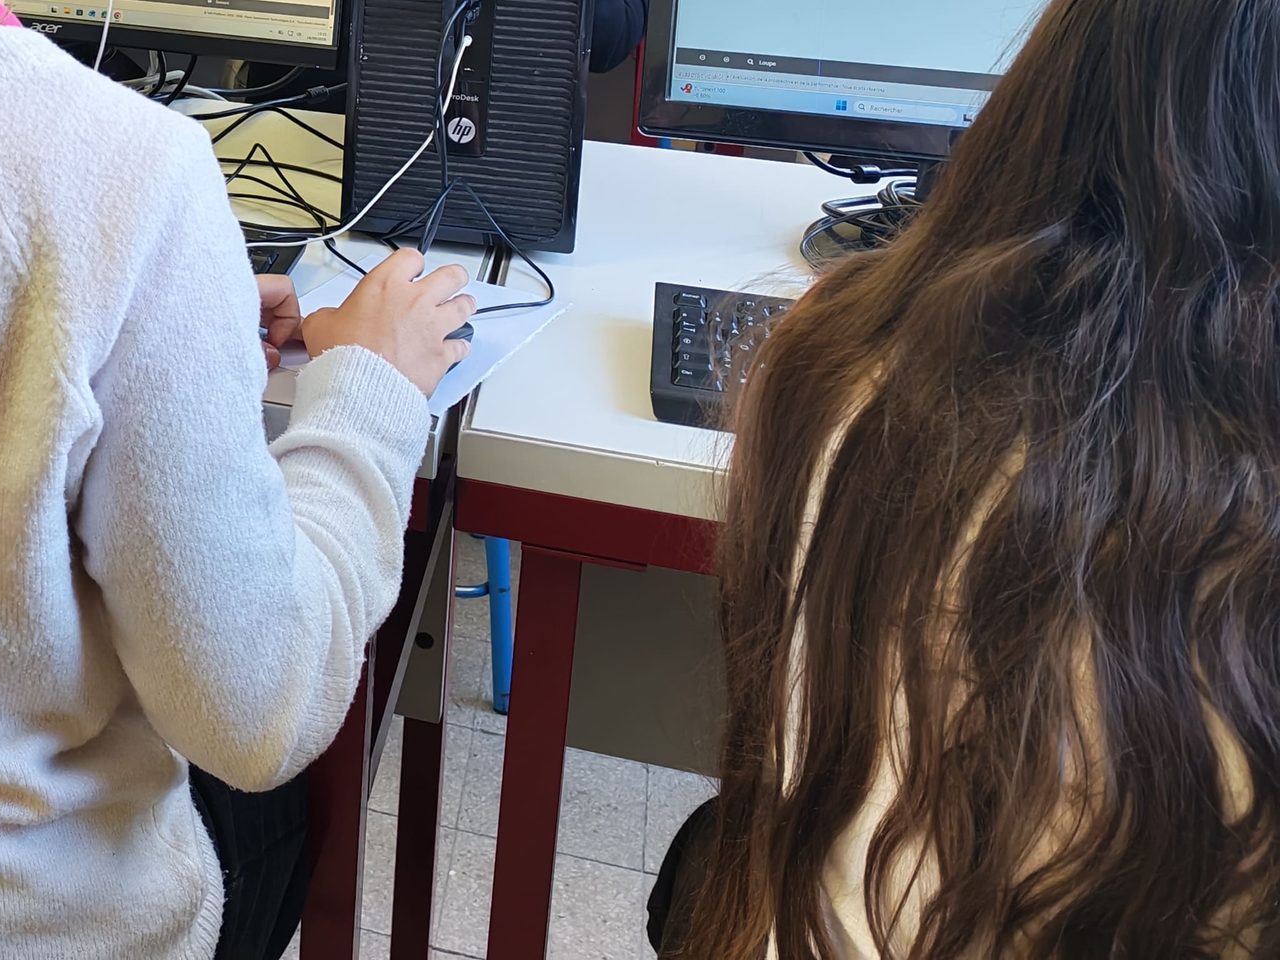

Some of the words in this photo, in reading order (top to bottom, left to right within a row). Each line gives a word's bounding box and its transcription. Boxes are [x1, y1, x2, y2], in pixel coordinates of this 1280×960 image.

[30, 22, 63, 34] acer
[758, 58, 778, 68] Loupe
[450, 94, 480, 102] roDesk
[450, 117, 474, 143] hp
